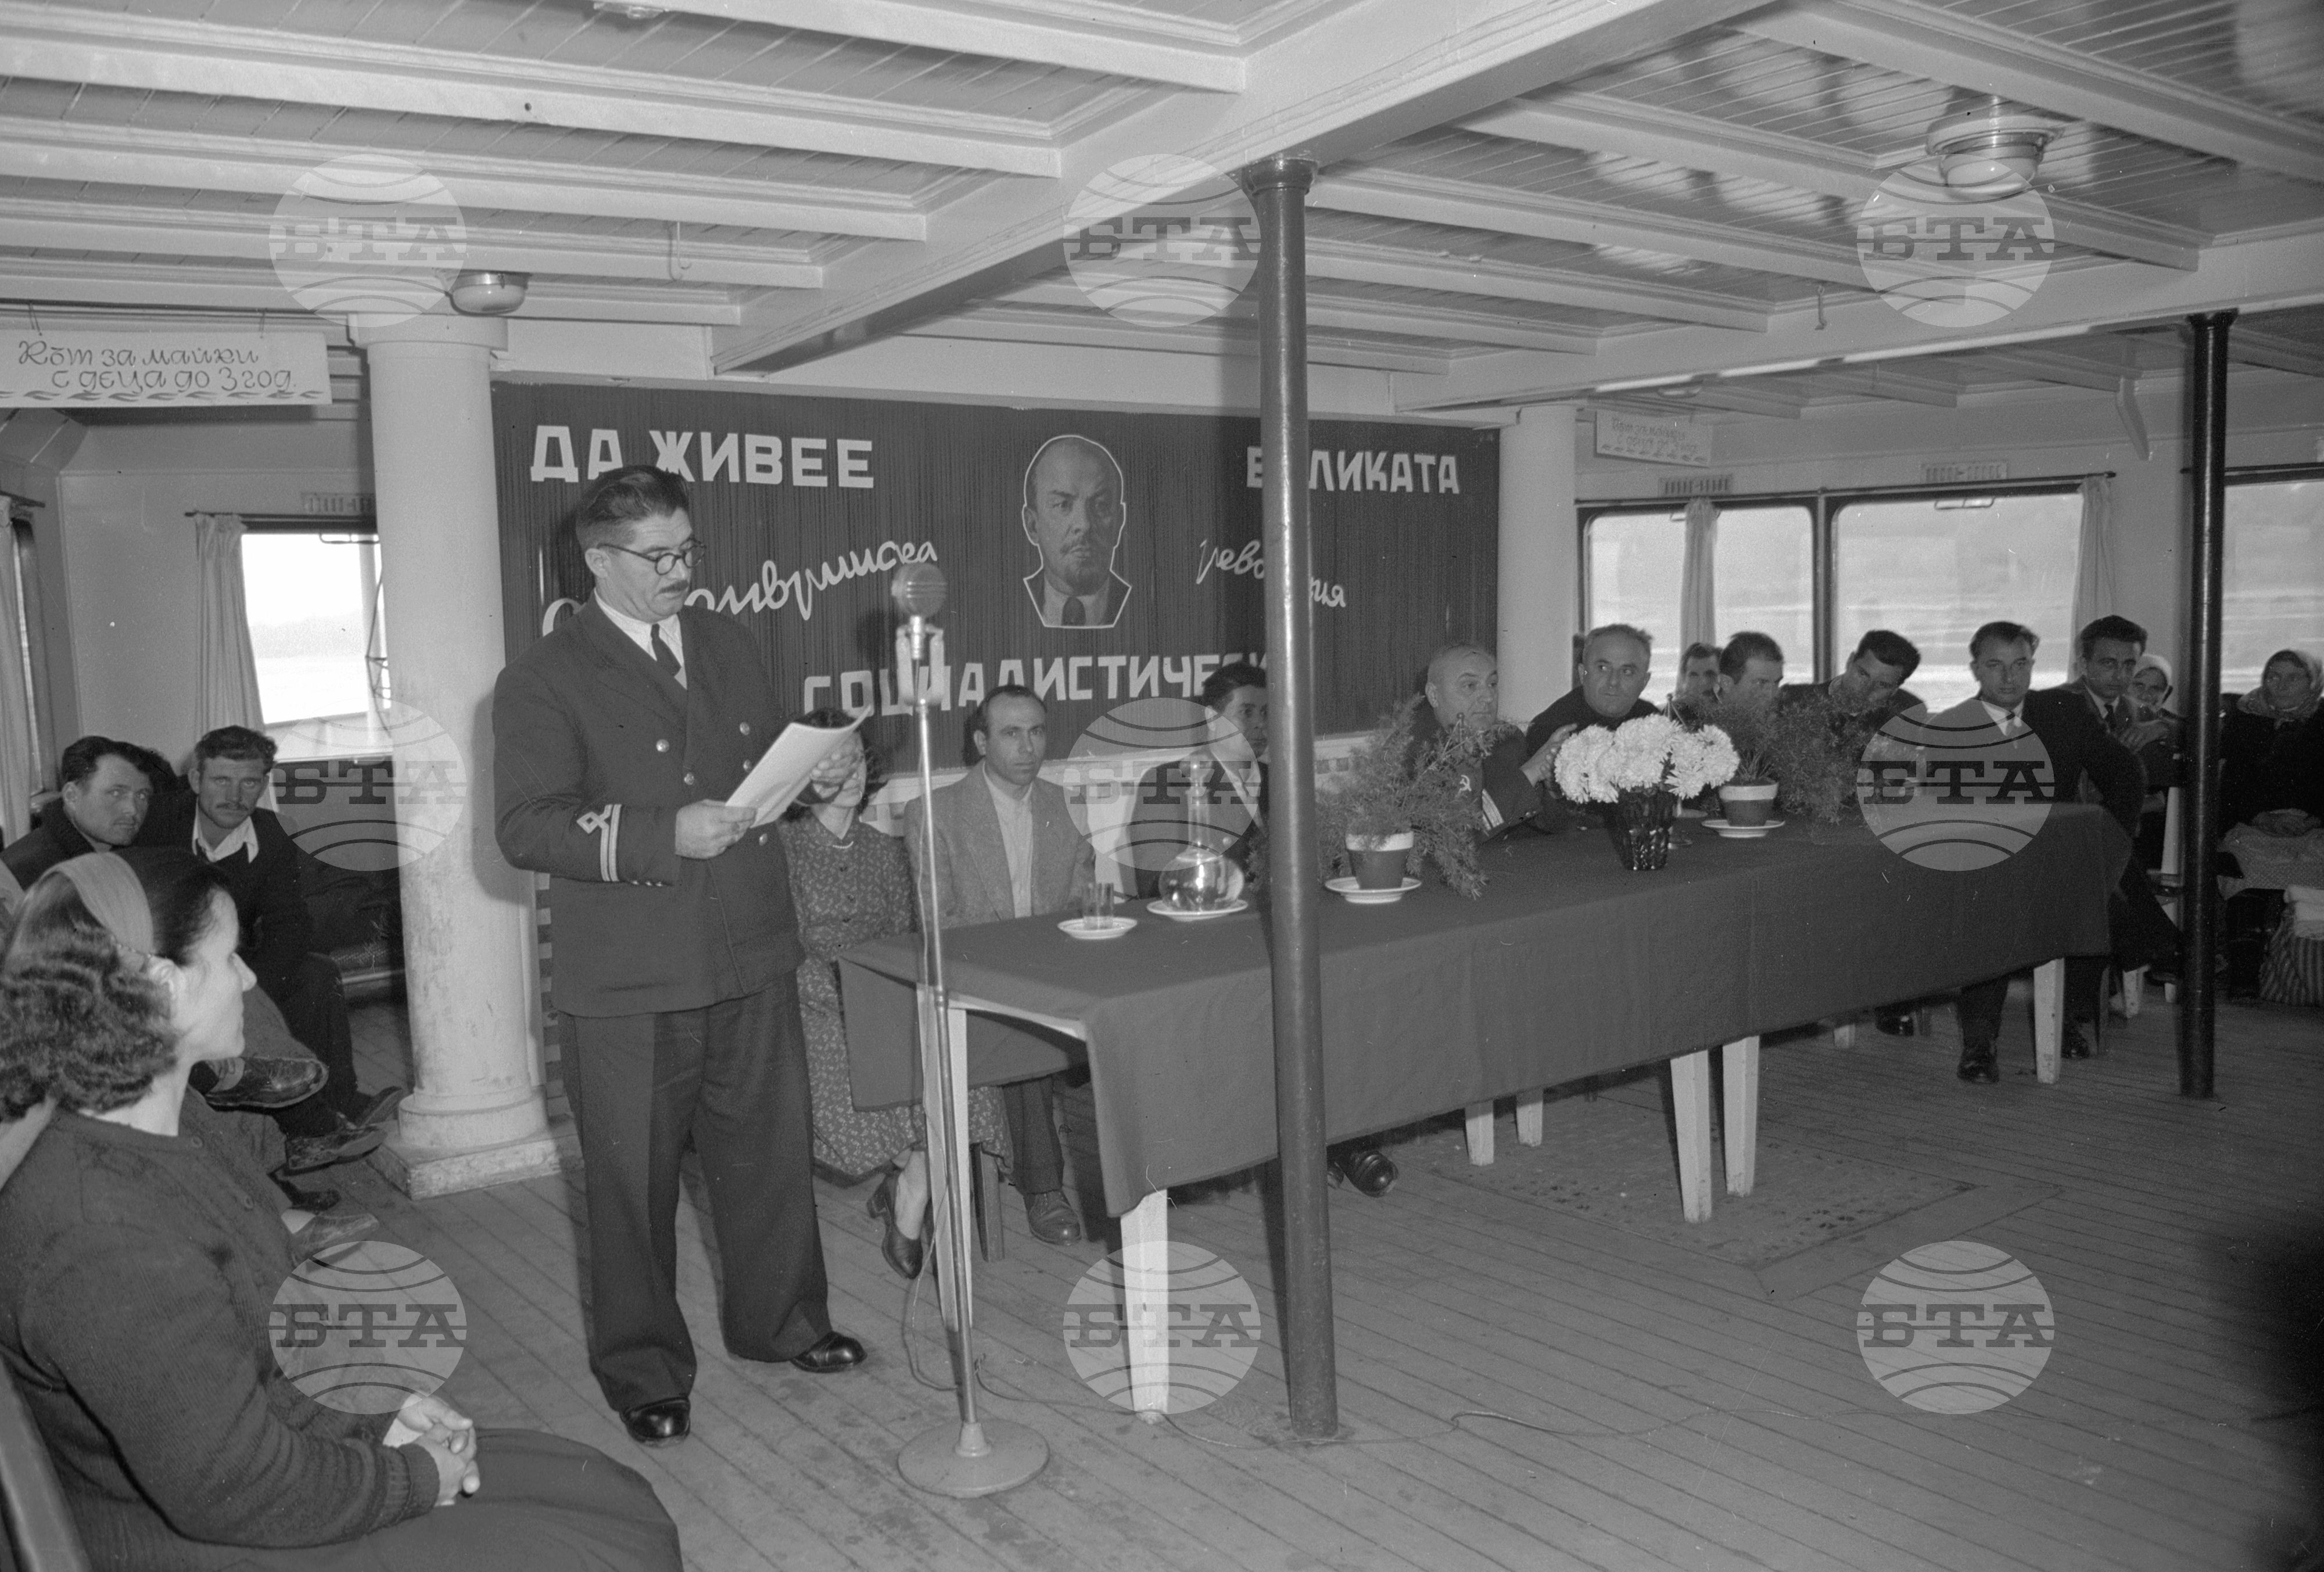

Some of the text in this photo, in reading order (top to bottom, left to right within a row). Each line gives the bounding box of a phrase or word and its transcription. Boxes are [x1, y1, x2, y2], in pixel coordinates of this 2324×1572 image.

[19, 340, 259, 367] Кът за майки
[52, 369, 69, 388] с
[78, 369, 166, 394] деца
[174, 370, 209, 393] до
[530, 425, 1459, 494] ДА ЖИВЕЕ ВЛИКАТА
[1196, 539, 1346, 608] ревоия
[804, 652, 1267, 717] СОЦИАЛИСТИЧЕ
